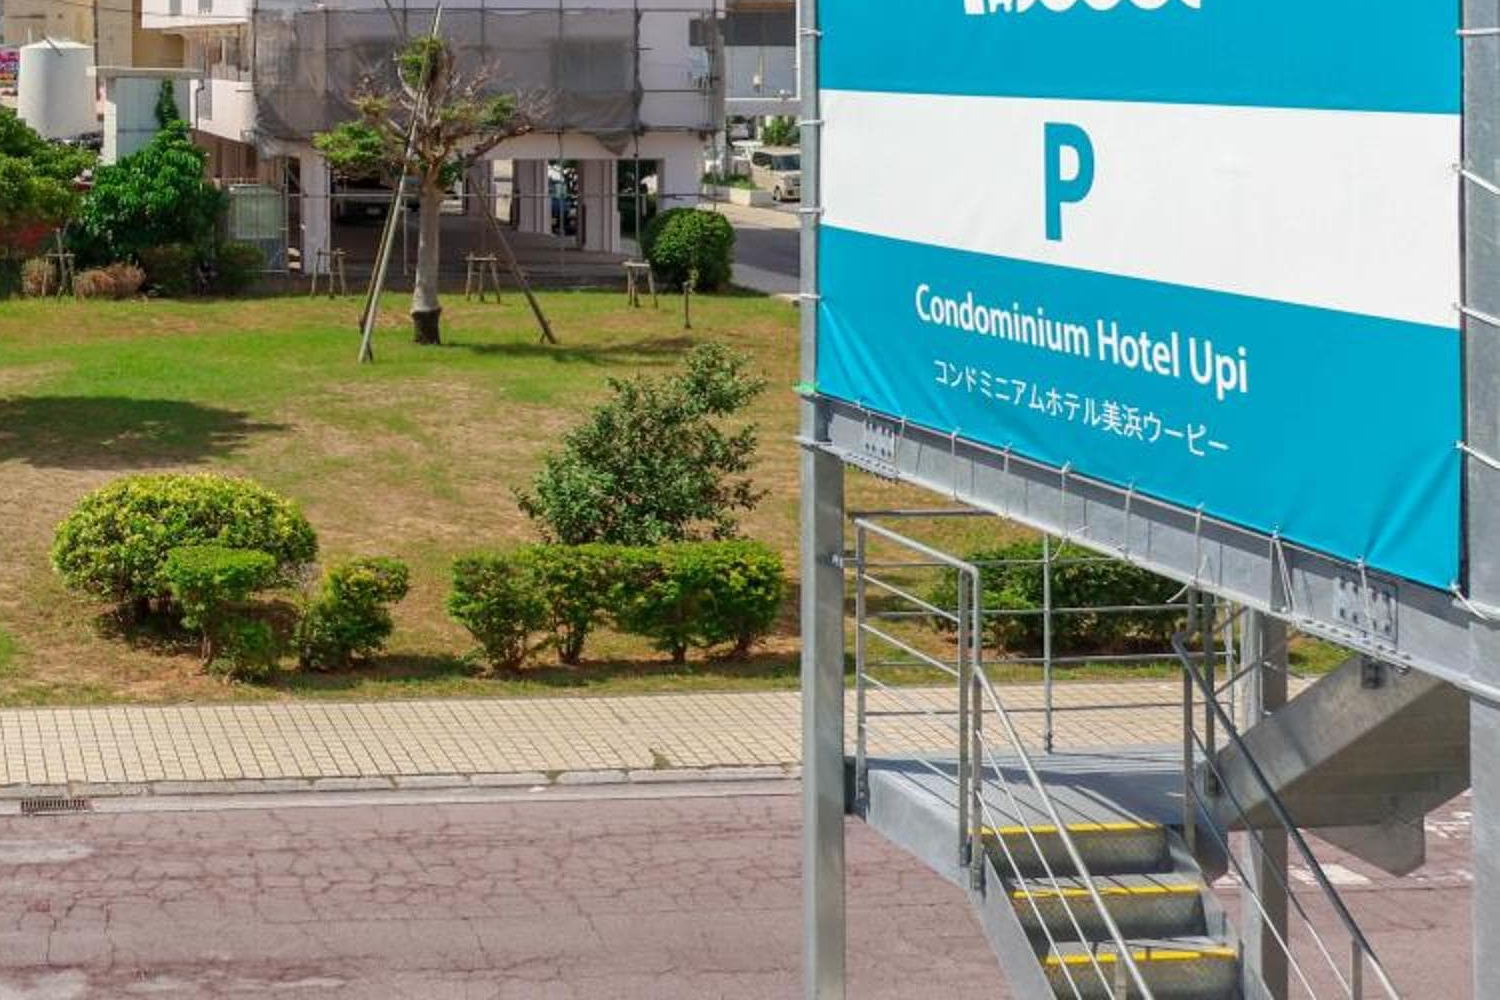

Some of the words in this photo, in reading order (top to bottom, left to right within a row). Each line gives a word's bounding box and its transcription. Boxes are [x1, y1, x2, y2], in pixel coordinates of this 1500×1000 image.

[1043, 121, 1095, 242] P
[915, 283, 1090, 357] Condominium
[1097, 319, 1180, 377] Hotel
[1189, 337, 1248, 401] Upi
[934, 360, 1228, 456] コンドミニアムホテル美浜ウーピー
